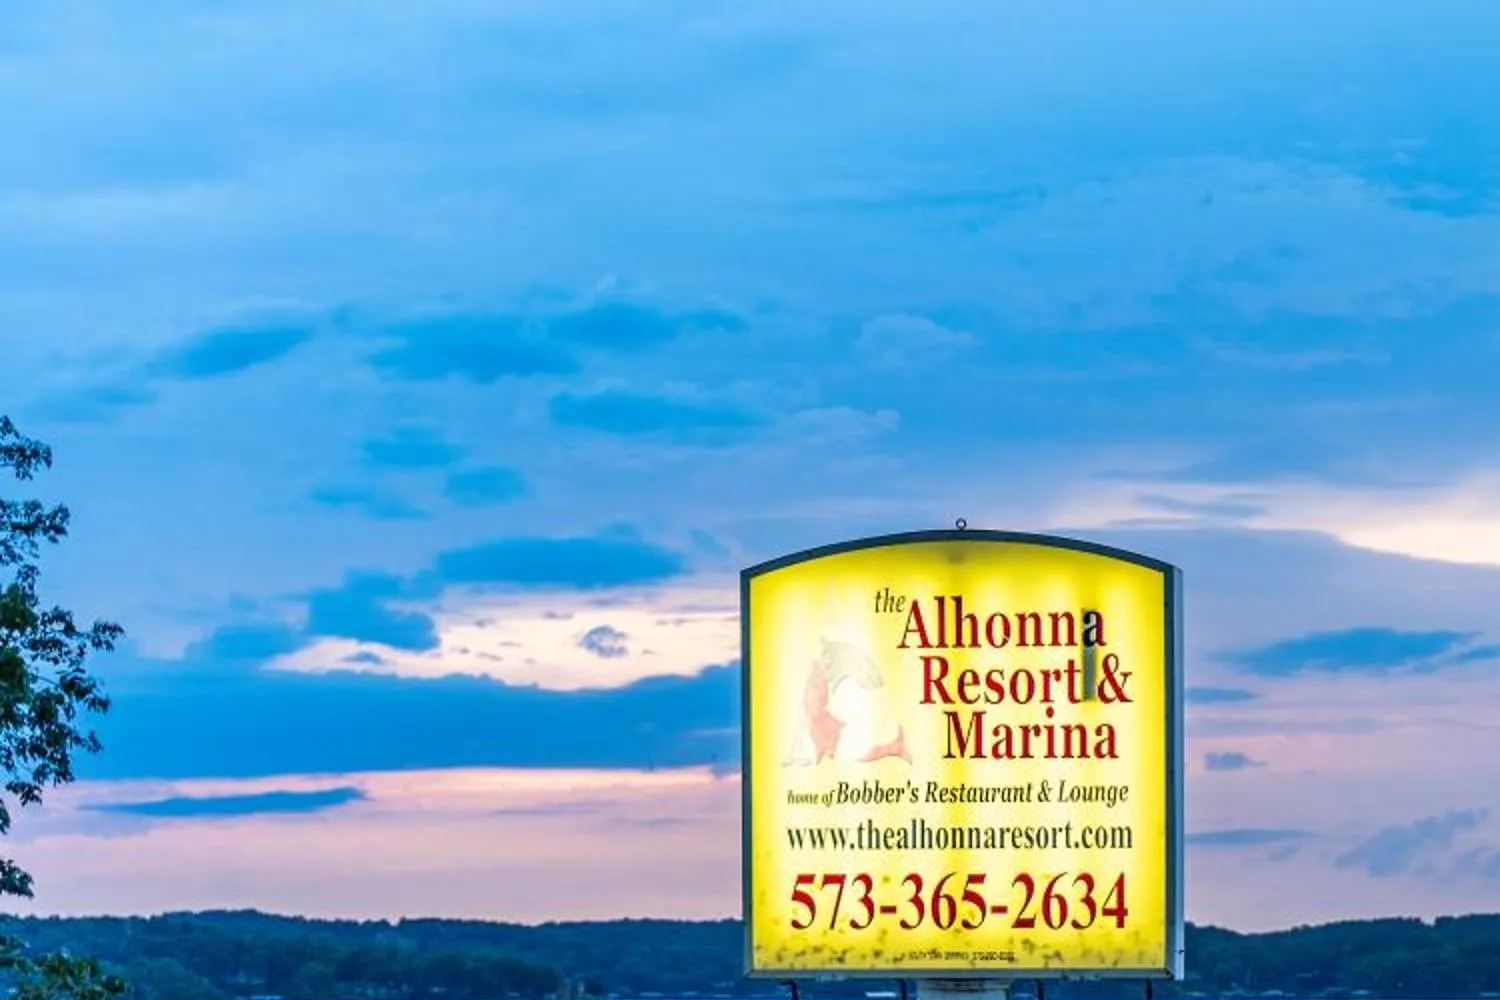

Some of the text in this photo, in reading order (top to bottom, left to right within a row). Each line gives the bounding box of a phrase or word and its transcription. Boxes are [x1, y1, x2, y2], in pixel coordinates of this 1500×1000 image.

[875, 588, 1108, 650] the Alhonna
[919, 653, 1134, 705] Resort &
[943, 706, 1119, 760] Marina
[787, 779, 1129, 808] home of Bobber's Restaurant & Lounge
[786, 818, 1133, 850] www.thealhonnaresort.com
[790, 871, 1129, 931] 573-365-2634
